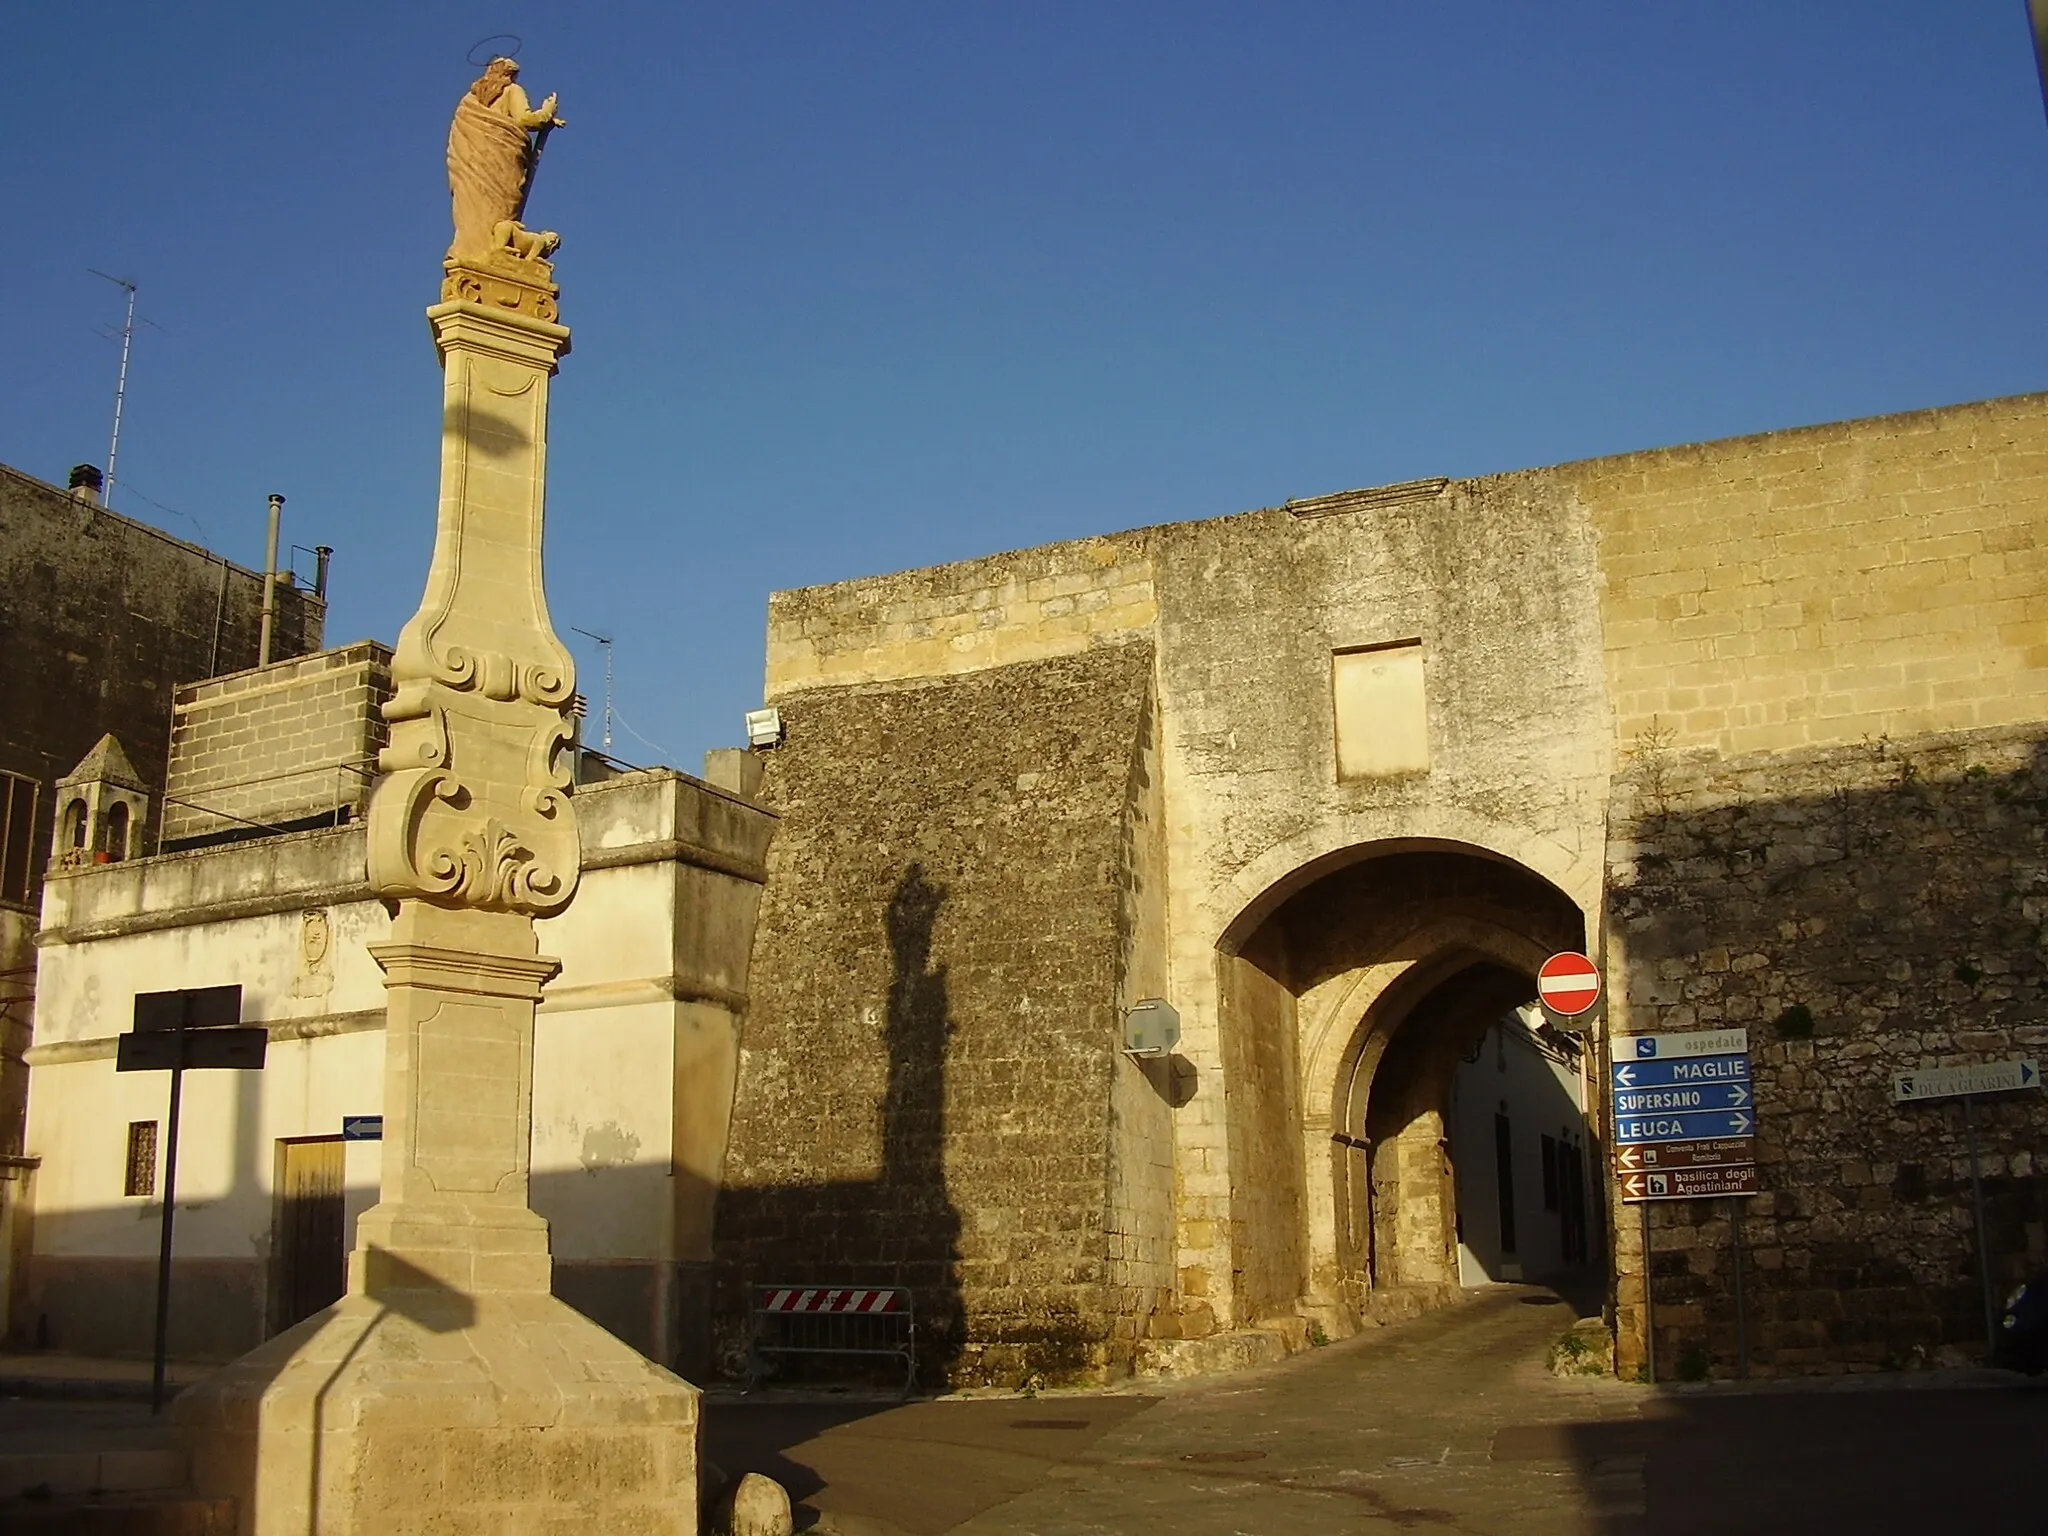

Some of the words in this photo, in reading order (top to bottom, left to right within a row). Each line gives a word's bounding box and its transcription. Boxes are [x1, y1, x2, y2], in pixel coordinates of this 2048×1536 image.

[1685, 1035, 1743, 1052] ospedale
[1673, 1060, 1745, 1079] MAGLIE
[1919, 1081, 1956, 1096] DUCA
[1958, 1074, 2016, 1092] GUARINI
[1619, 1092, 1700, 1110] SUPERSANO
[1619, 1120, 1683, 1138] LEUCA
[1696, 1142, 1711, 1152] Frati
[1675, 1171, 1719, 1182] basilica
[1726, 1168, 1755, 1183] degli
[1676, 1180, 1743, 1196] Agostiniani
